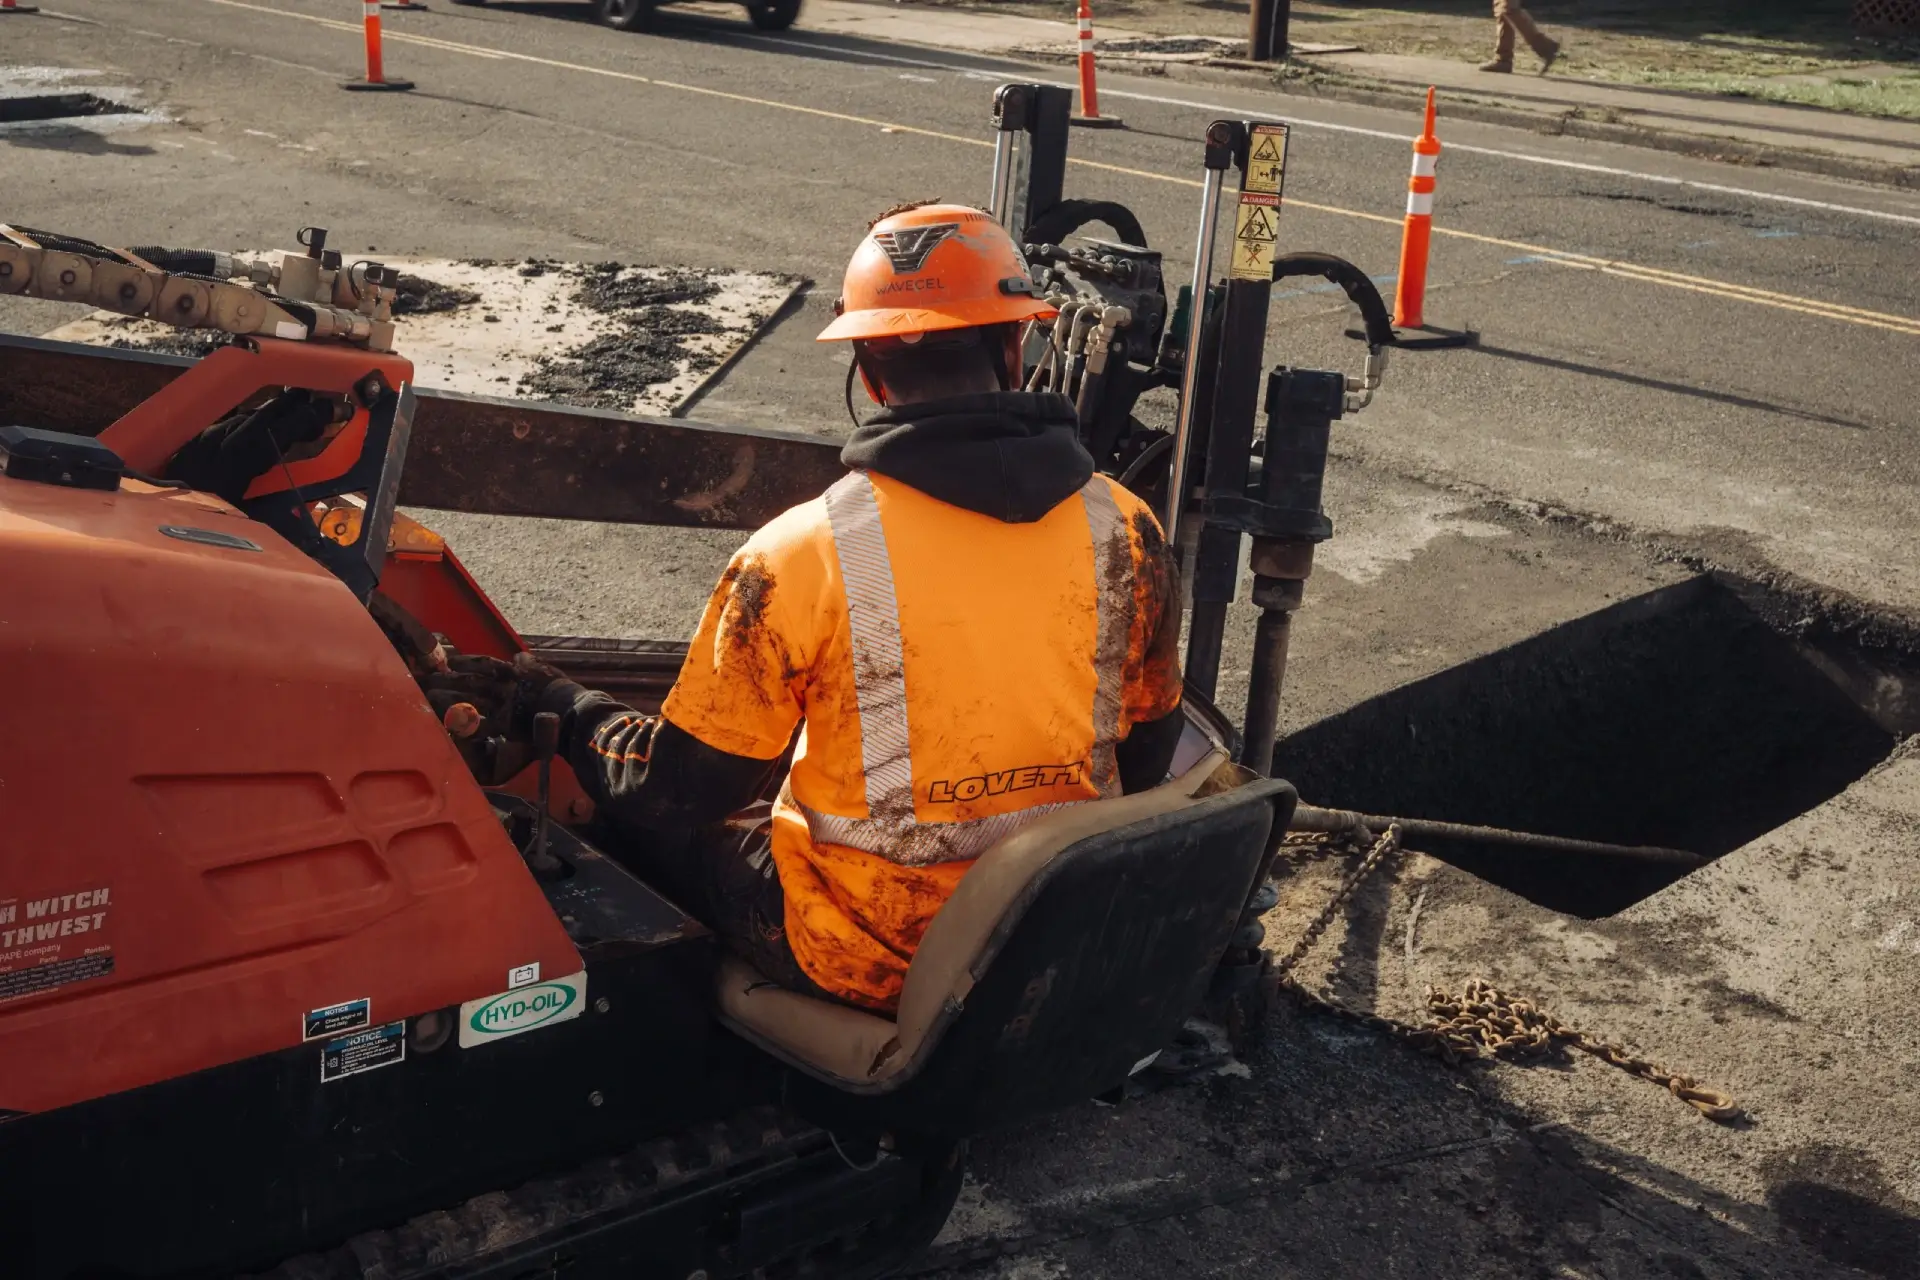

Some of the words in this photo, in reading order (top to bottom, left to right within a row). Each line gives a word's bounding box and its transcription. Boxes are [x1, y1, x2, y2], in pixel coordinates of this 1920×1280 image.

[876, 278, 945, 295] WAVECEL
[928, 761, 1084, 803] LOVETT
[26, 888, 110, 919] WITCH
[24, 944, 61, 958] company
[324, 1005, 349, 1016] NOTICE
[485, 991, 563, 1025] HYD-OIL
[346, 1030, 382, 1046] NOTICE
